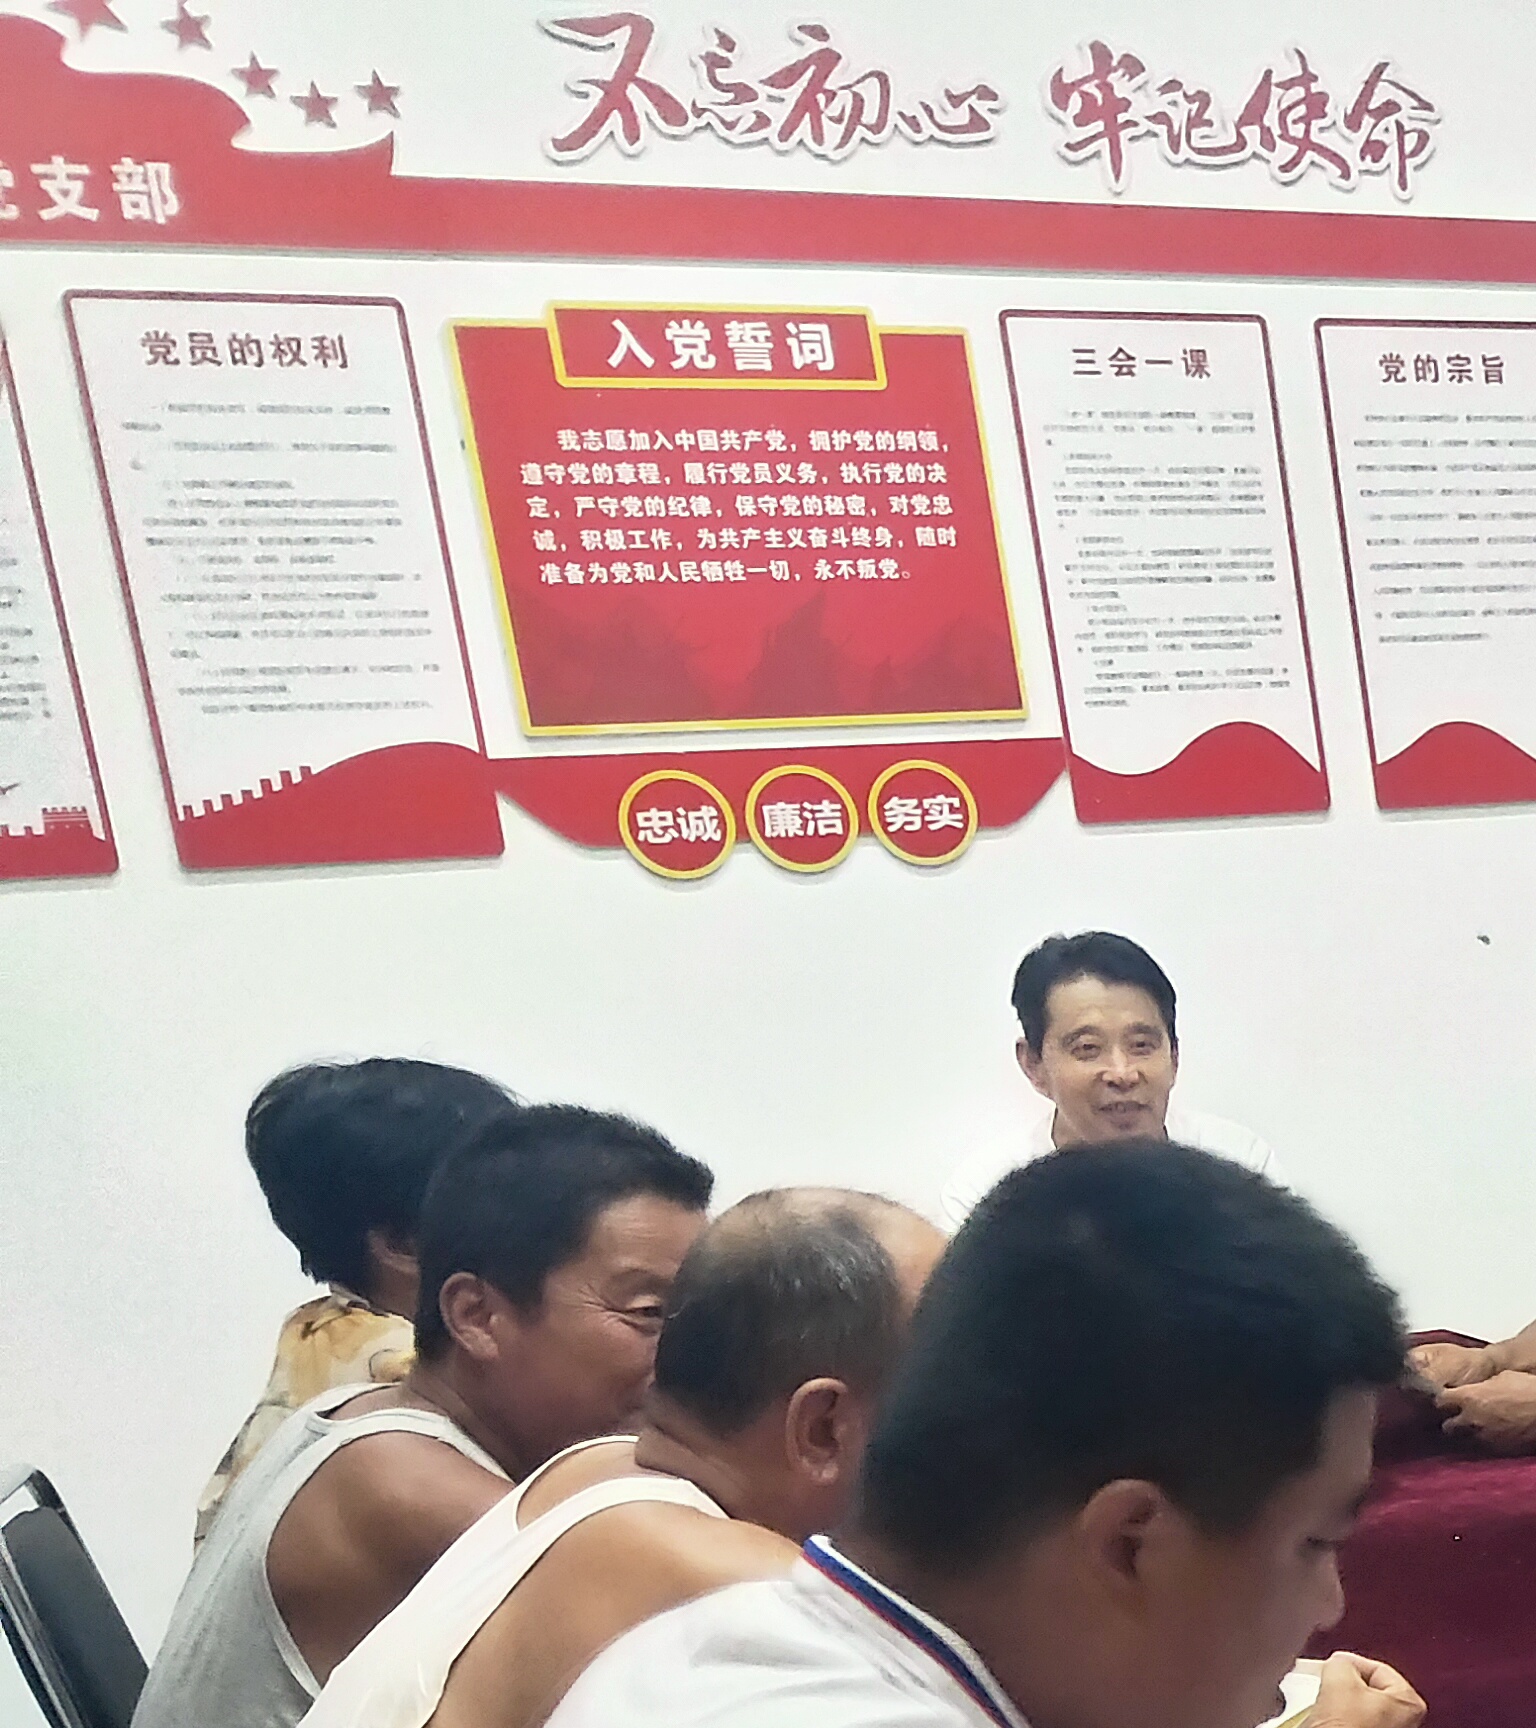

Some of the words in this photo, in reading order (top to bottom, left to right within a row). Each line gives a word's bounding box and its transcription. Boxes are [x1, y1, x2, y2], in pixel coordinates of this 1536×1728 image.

[551, 12, 999, 153] 不忘初心
[1050, 39, 1434, 192] 牢记使命
[141, 330, 348, 369] 党员的权利
[606, 318, 836, 372] 入党誓词
[1072, 347, 1211, 380] 三会一课
[1379, 352, 1506, 385] 党的宗旨
[540, 558, 912, 585] 准备为党和人民牺牲一切，永不叛党。
[635, 806, 722, 844] 忠诚
[761, 799, 844, 838] 廉洁
[883, 794, 965, 834] 务实
